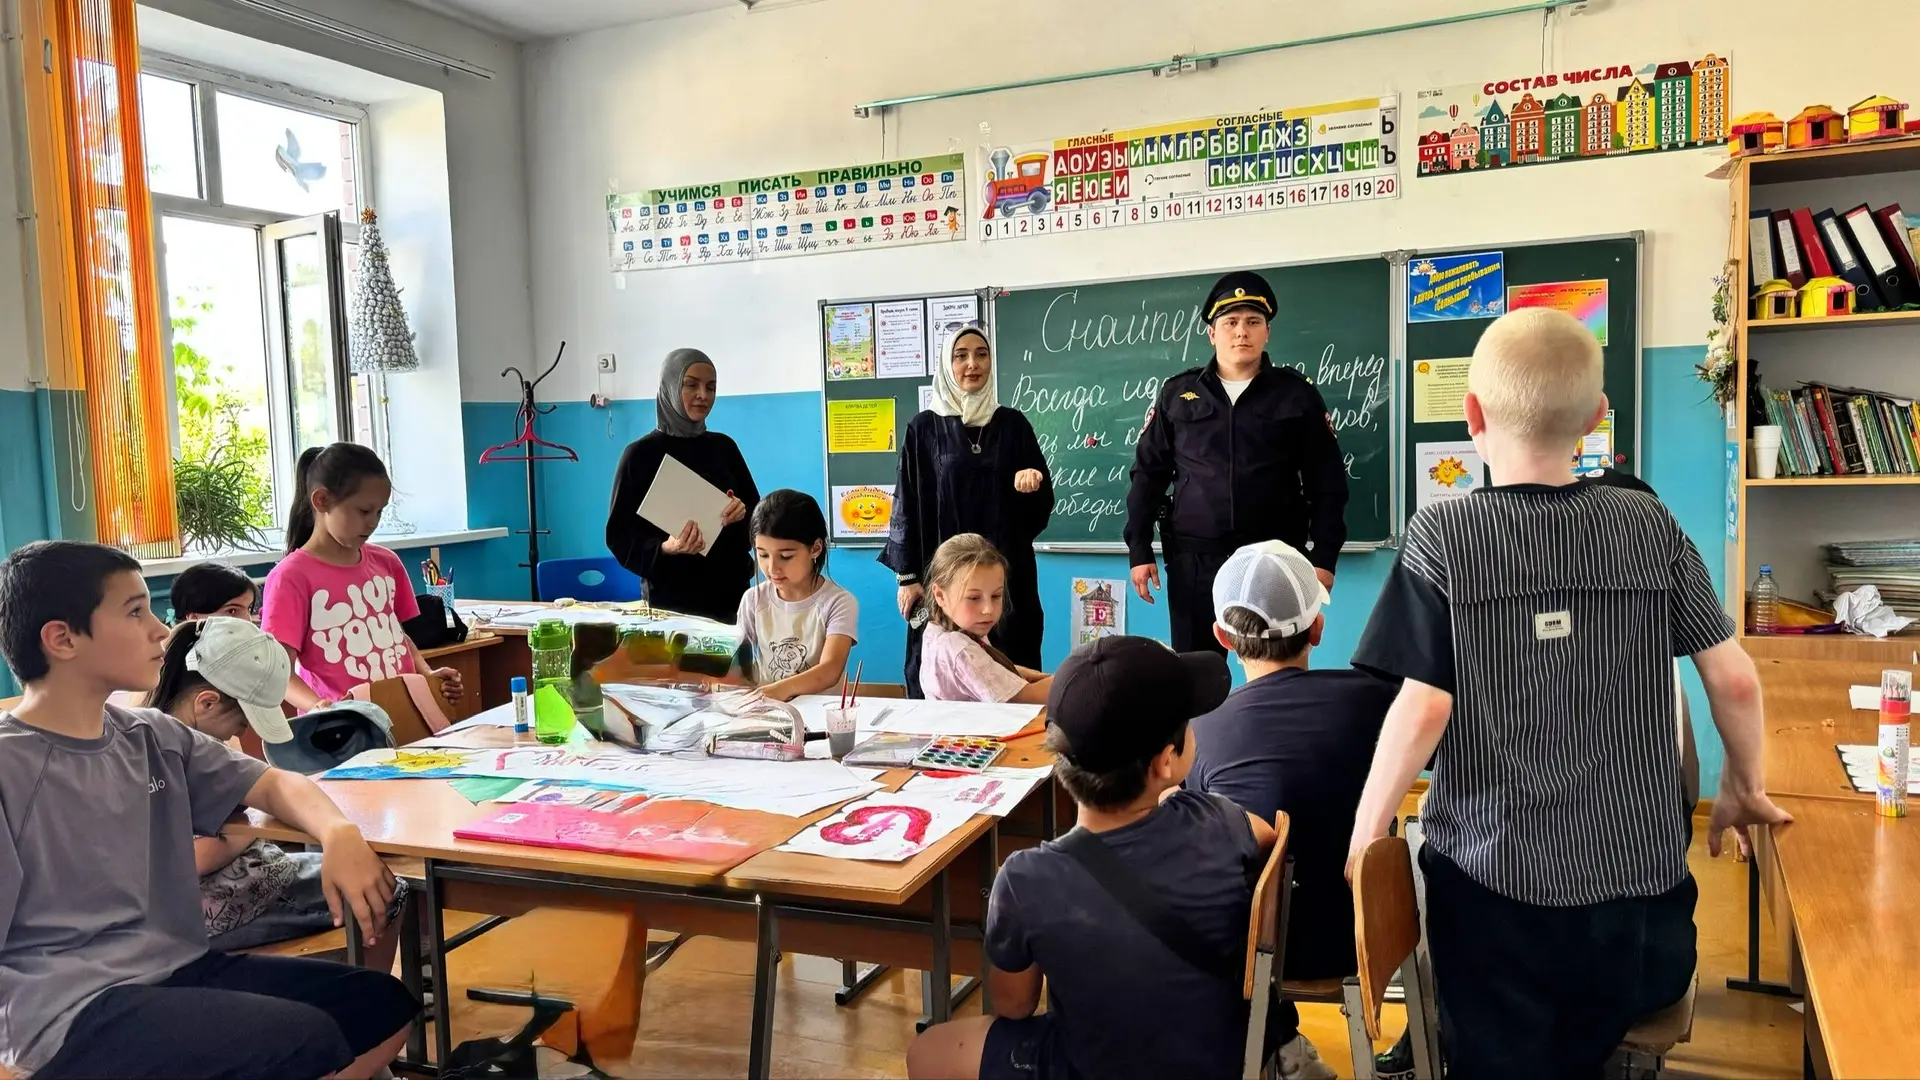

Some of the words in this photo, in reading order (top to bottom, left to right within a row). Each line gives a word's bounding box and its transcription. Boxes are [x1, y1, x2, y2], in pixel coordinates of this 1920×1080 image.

[1483, 75, 1558, 96] СОСТАВ
[1563, 65, 1634, 85] ЧИСЛА
[1216, 111, 1283, 127] СОГЛАСНЫЕ
[1382, 115, 1395, 135] Ь
[1055, 156, 1068, 175] А
[1070, 154, 1082, 173] О
[1085, 151, 1097, 172] У
[1100, 150, 1112, 169] Э
[1115, 148, 1128, 169] Ы
[1131, 140, 1143, 166] Й
[1146, 143, 1158, 163] Н
[1161, 141, 1175, 162] М
[1177, 139, 1191, 160] Л
[1194, 137, 1206, 157] Р
[1210, 135, 1223, 156] Б
[1226, 133, 1239, 154] В
[1244, 131, 1255, 152] Г
[1259, 129, 1274, 151] Д
[1276, 127, 1291, 148] Ж
[1295, 125, 1307, 145] З
[1067, 133, 1114, 147] ГЛАСНЫЕ
[1381, 145, 1396, 164] Ъ
[658, 185, 722, 203] УЧИМСЯ
[738, 175, 801, 194] ПИСАТЬ
[817, 160, 922, 185] ПРАВИЛЬНО
[1210, 165, 1222, 184] П
[1227, 163, 1240, 182] Ф
[1244, 161, 1256, 181] К
[1260, 159, 1273, 179] Т
[1276, 156, 1291, 178] Ш
[1294, 155, 1306, 174] С
[1311, 153, 1324, 173] Х
[1328, 150, 1342, 172] Ц
[1346, 149, 1359, 168] Ч
[1363, 147, 1379, 168] Щ
[985, 224, 992, 236] 0
[1003, 222, 1009, 234] 1
[1020, 220, 1027, 233] 2
[1038, 218, 1045, 231] 3
[1056, 216, 1063, 228] 4
[1075, 214, 1082, 227] 5
[1093, 212, 1100, 224] 6
[1112, 210, 1119, 222] 7
[1131, 208, 1139, 221] 8
[1150, 206, 1158, 218] 9
[1166, 203, 1181, 217] 10
[1187, 200, 1201, 214] 11
[1206, 198, 1221, 213] 12
[1227, 196, 1242, 210] 13
[1247, 193, 1263, 208] 14
[1268, 191, 1284, 206] 15
[1289, 189, 1306, 203] 16
[1311, 186, 1327, 201] 17
[1332, 184, 1350, 199] 18
[1354, 182, 1372, 197] 19
[1377, 179, 1394, 194] 20
[1056, 182, 1067, 203] Я
[1071, 177, 1082, 201] Ё
[1085, 179, 1099, 199] Ю
[1101, 178, 1111, 198] Е
[1116, 175, 1128, 196] И
[1012, 373, 1108, 432] Всегда
[1051, 492, 1124, 532] обеды
[310, 575, 396, 631] LIVE
